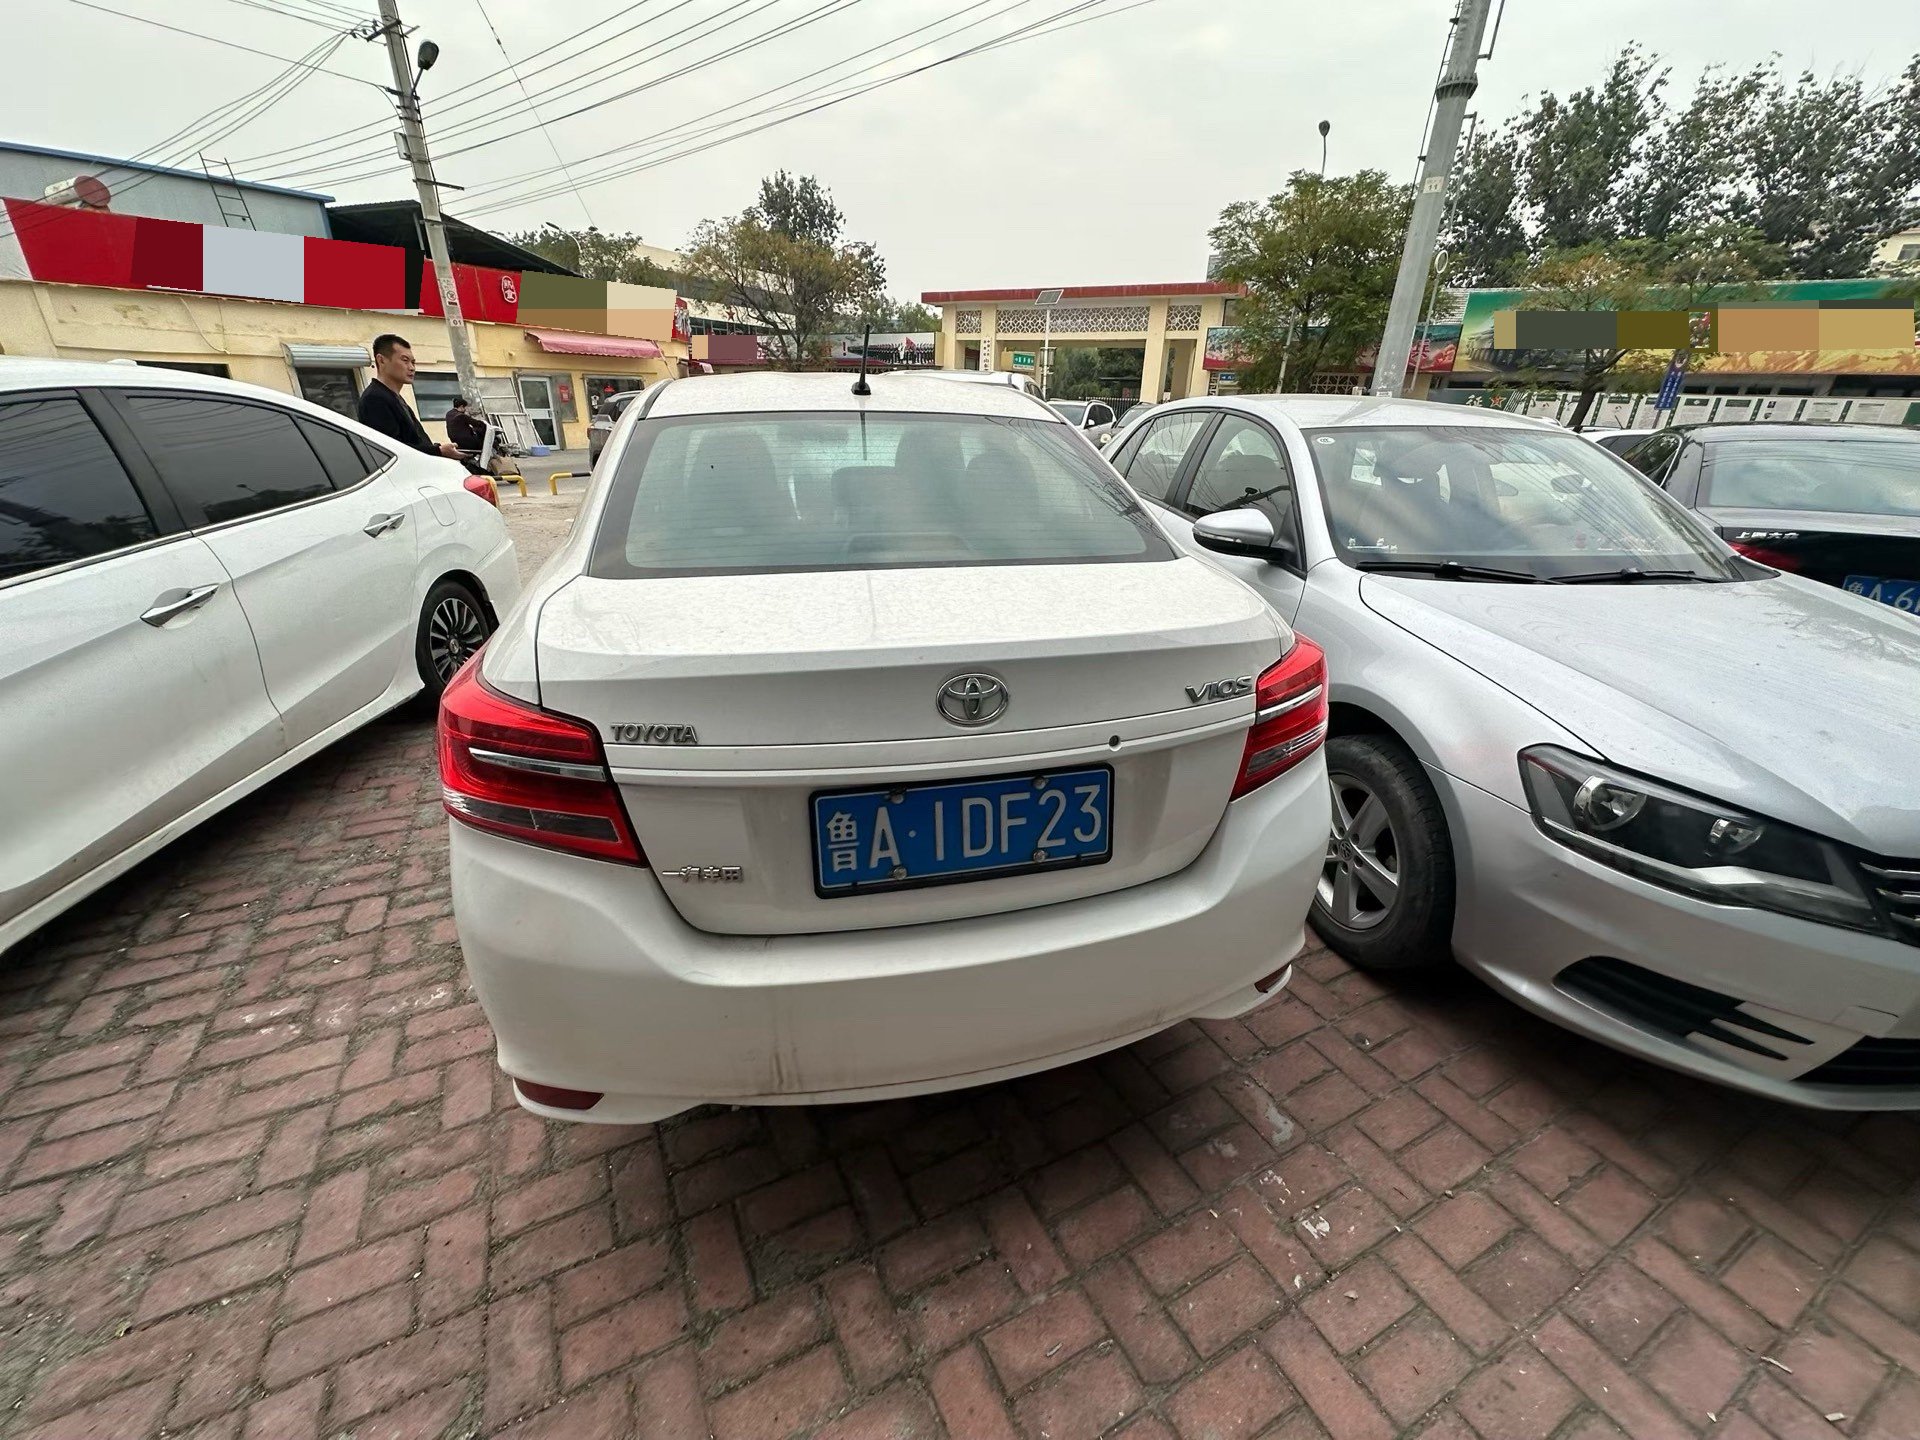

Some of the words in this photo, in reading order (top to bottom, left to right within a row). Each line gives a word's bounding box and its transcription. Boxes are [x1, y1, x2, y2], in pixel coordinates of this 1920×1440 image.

[1185, 675, 1252, 703] VIOS
[610, 722, 698, 744] TOYOTA
[662, 865, 744, 882] 一汽丰田
